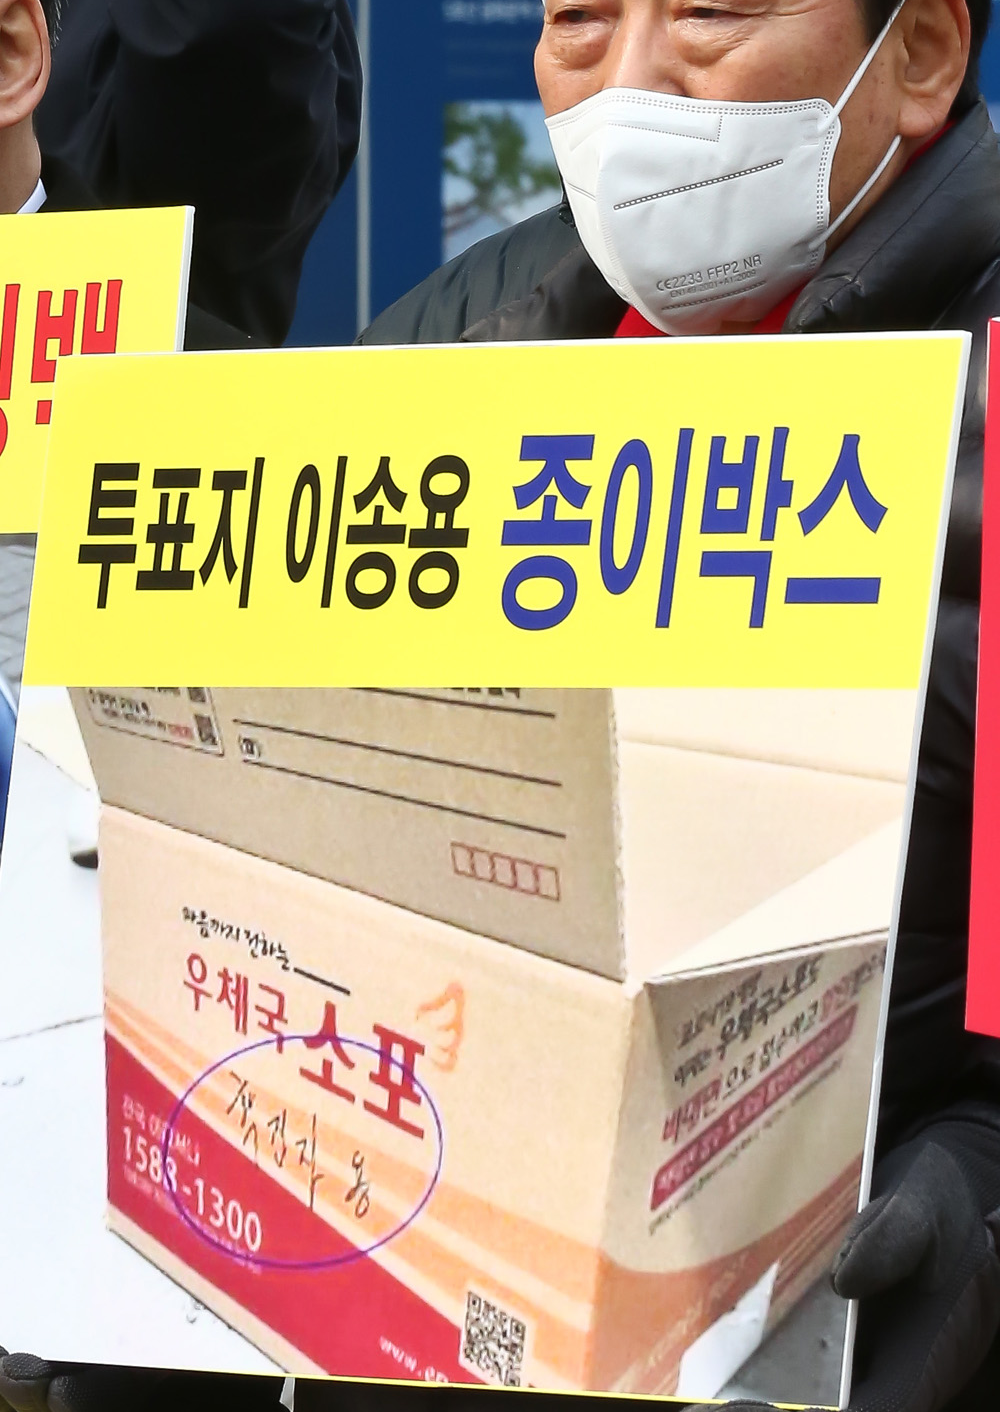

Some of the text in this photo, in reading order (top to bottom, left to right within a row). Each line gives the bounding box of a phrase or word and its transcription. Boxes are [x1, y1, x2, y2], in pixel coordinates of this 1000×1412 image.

[706, 260, 740, 281] FFP2
[743, 253, 762, 270] NR
[76, 426, 890, 632] 투표지 이송용 종이박스
[182, 905, 240, 943] 마음까지
[183, 952, 426, 1140] 우체국 소포
[122, 1125, 262, 1253] 1588-1300
